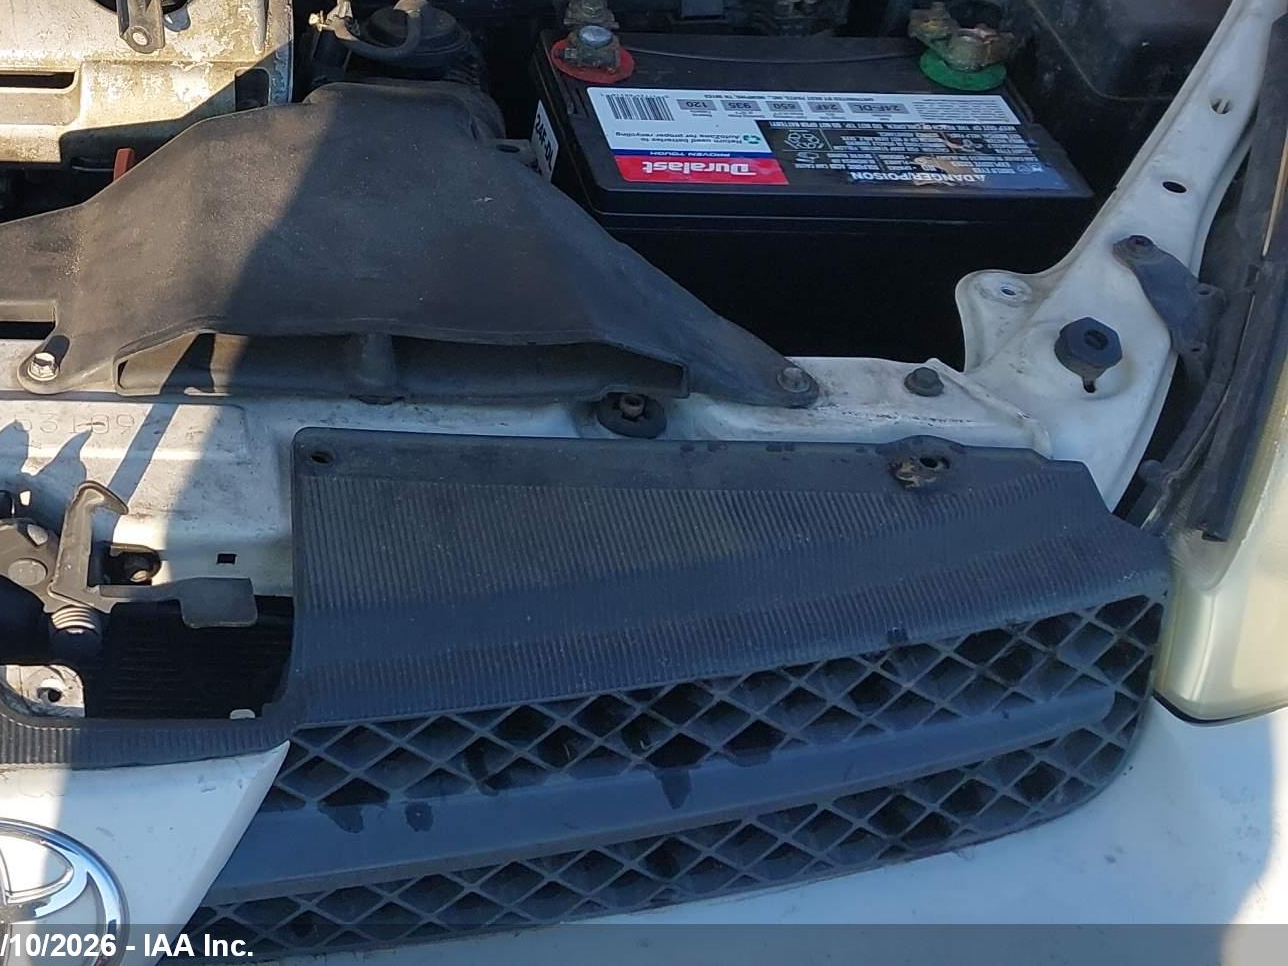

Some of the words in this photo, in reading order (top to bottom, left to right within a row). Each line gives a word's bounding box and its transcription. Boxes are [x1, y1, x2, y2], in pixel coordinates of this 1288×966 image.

[854, 104, 901, 112] 24F-DL
[642, 161, 757, 176] Duralast
[850, 172, 976, 182] DANGER/POISON
